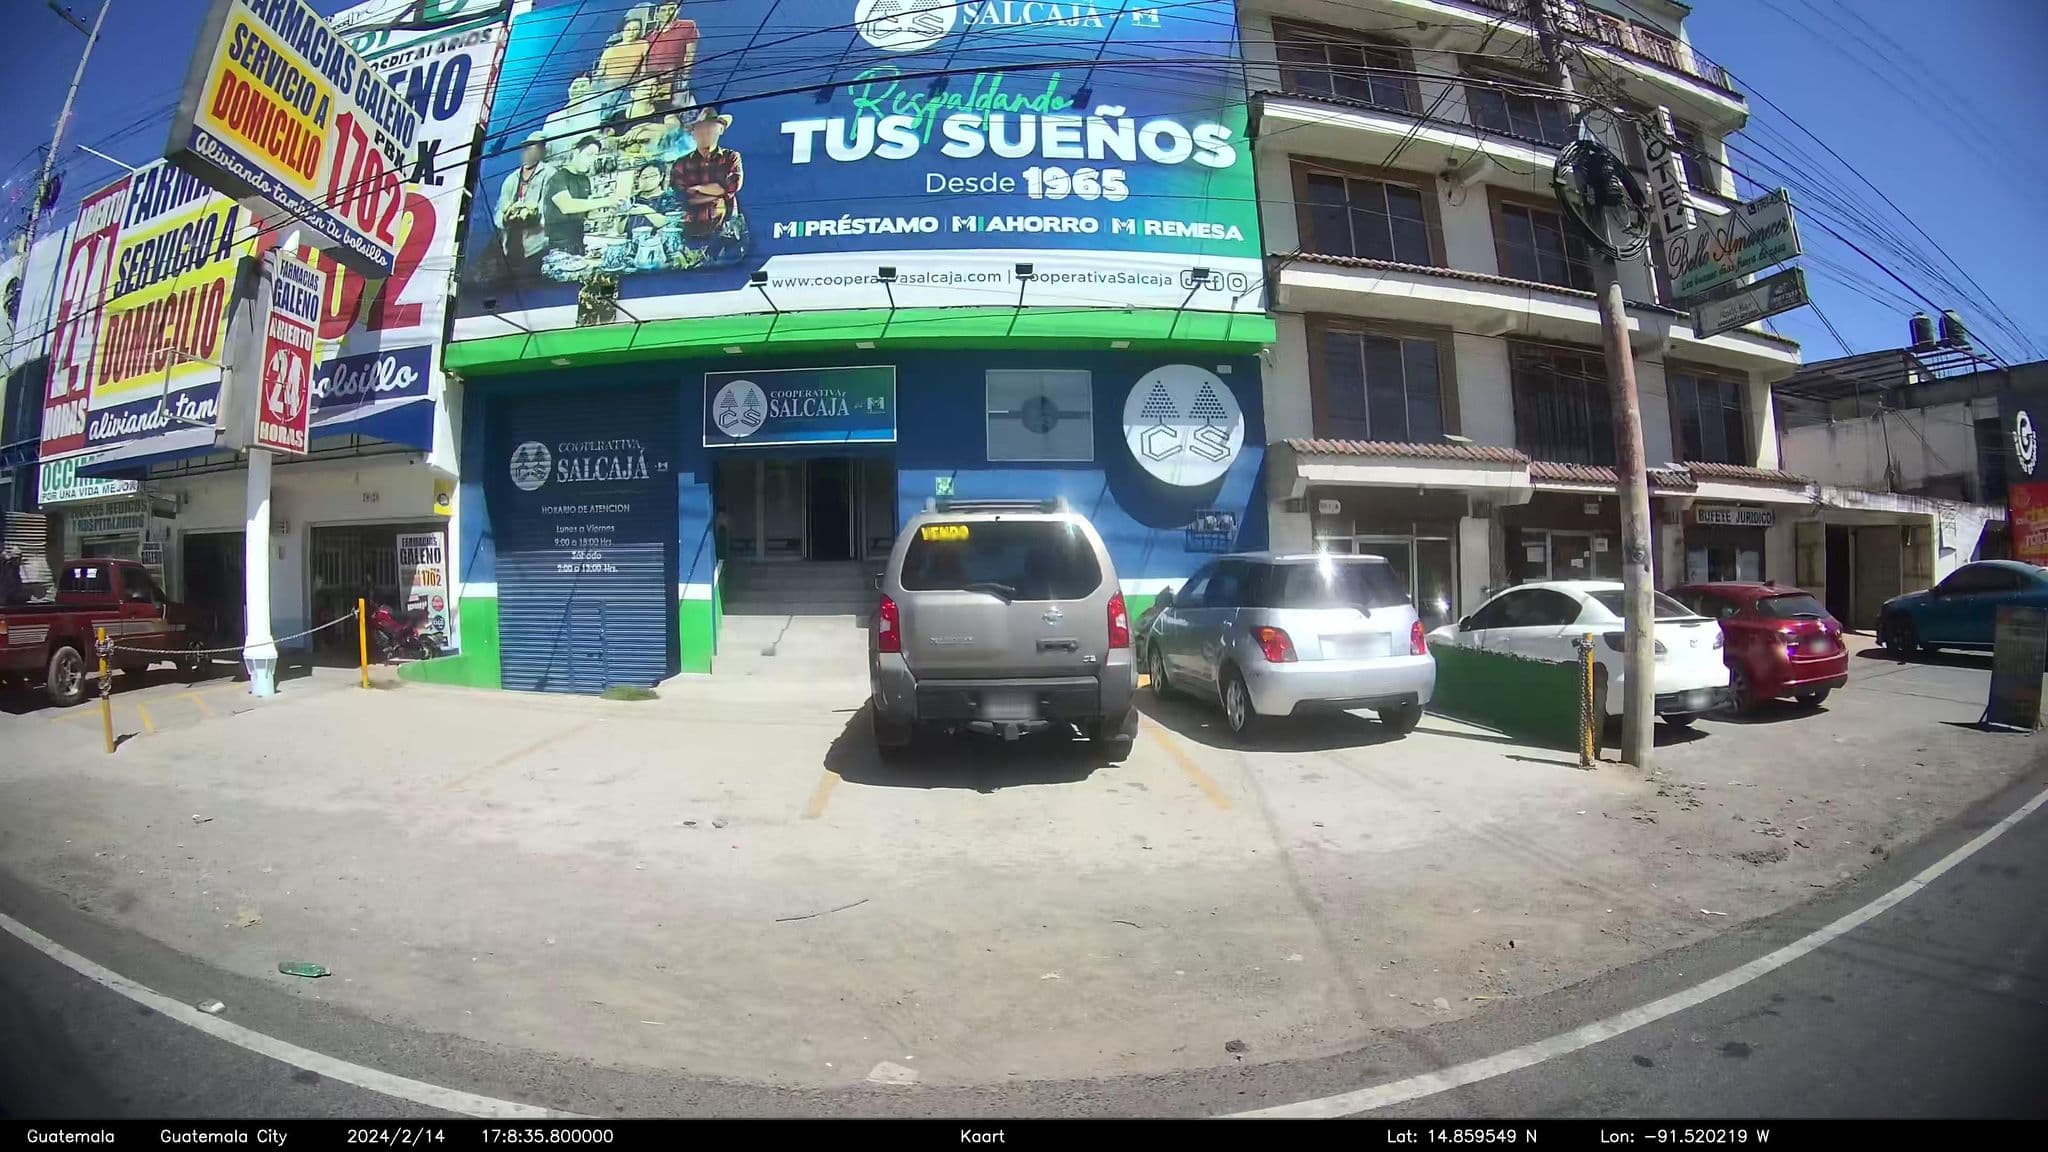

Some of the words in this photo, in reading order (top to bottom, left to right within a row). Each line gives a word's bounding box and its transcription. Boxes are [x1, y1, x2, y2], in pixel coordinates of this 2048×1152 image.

[229, 22, 316, 116] SERVICIO
[313, 94, 330, 130] A
[240, 0, 356, 94] ARMACIAS
[355, 68, 415, 149] GALENO
[849, 65, 1073, 146] Respaldando
[211, 68, 321, 180] DOMICILIO
[780, 116, 921, 164] TUS
[940, 105, 1236, 169] SUEÑOS
[326, 111, 400, 247] 1702
[926, 171, 1015, 194] Desde
[1022, 166, 1129, 201] 1965
[1640, 112, 1684, 234] OTEL
[805, 214, 938, 236] PRÉSTAMO
[987, 216, 1098, 233] AHORRO
[1145, 219, 1244, 241] REMESA
[114, 213, 218, 298] SERVICIO
[214, 205, 240, 263] A
[327, 218, 342, 240] tu
[343, 229, 388, 267] bolsillo
[280, 260, 319, 292] FARMACIAS
[772, 270, 1001, 289] www.cooperaasalcaja.com
[1020, 272, 1172, 288] ooperativaSalcaja
[273, 278, 319, 323] GALENO
[50, 237, 110, 399] 24
[99, 277, 226, 386] DOMICILIO
[269, 318, 312, 351] ABIERTO
[268, 350, 302, 416] 24
[771, 389, 841, 398] COOPERATIVA
[43, 398, 88, 441] HORAS
[89, 400, 170, 441] aliviando
[770, 392, 849, 418] SALCAJÁ
[260, 421, 304, 448] HORAS
[558, 440, 642, 453] COOPERATIVA
[557, 450, 650, 482] SALCAJÁ
[80, 485, 99, 496] VIDA
[542, 505, 576, 514] HORARIO
[578, 505, 588, 513] DE
[556, 525, 578, 533] Lunes
[921, 526, 969, 541] VENDO
[400, 547, 441, 565] GALENO
[421, 569, 441, 586] 1702
